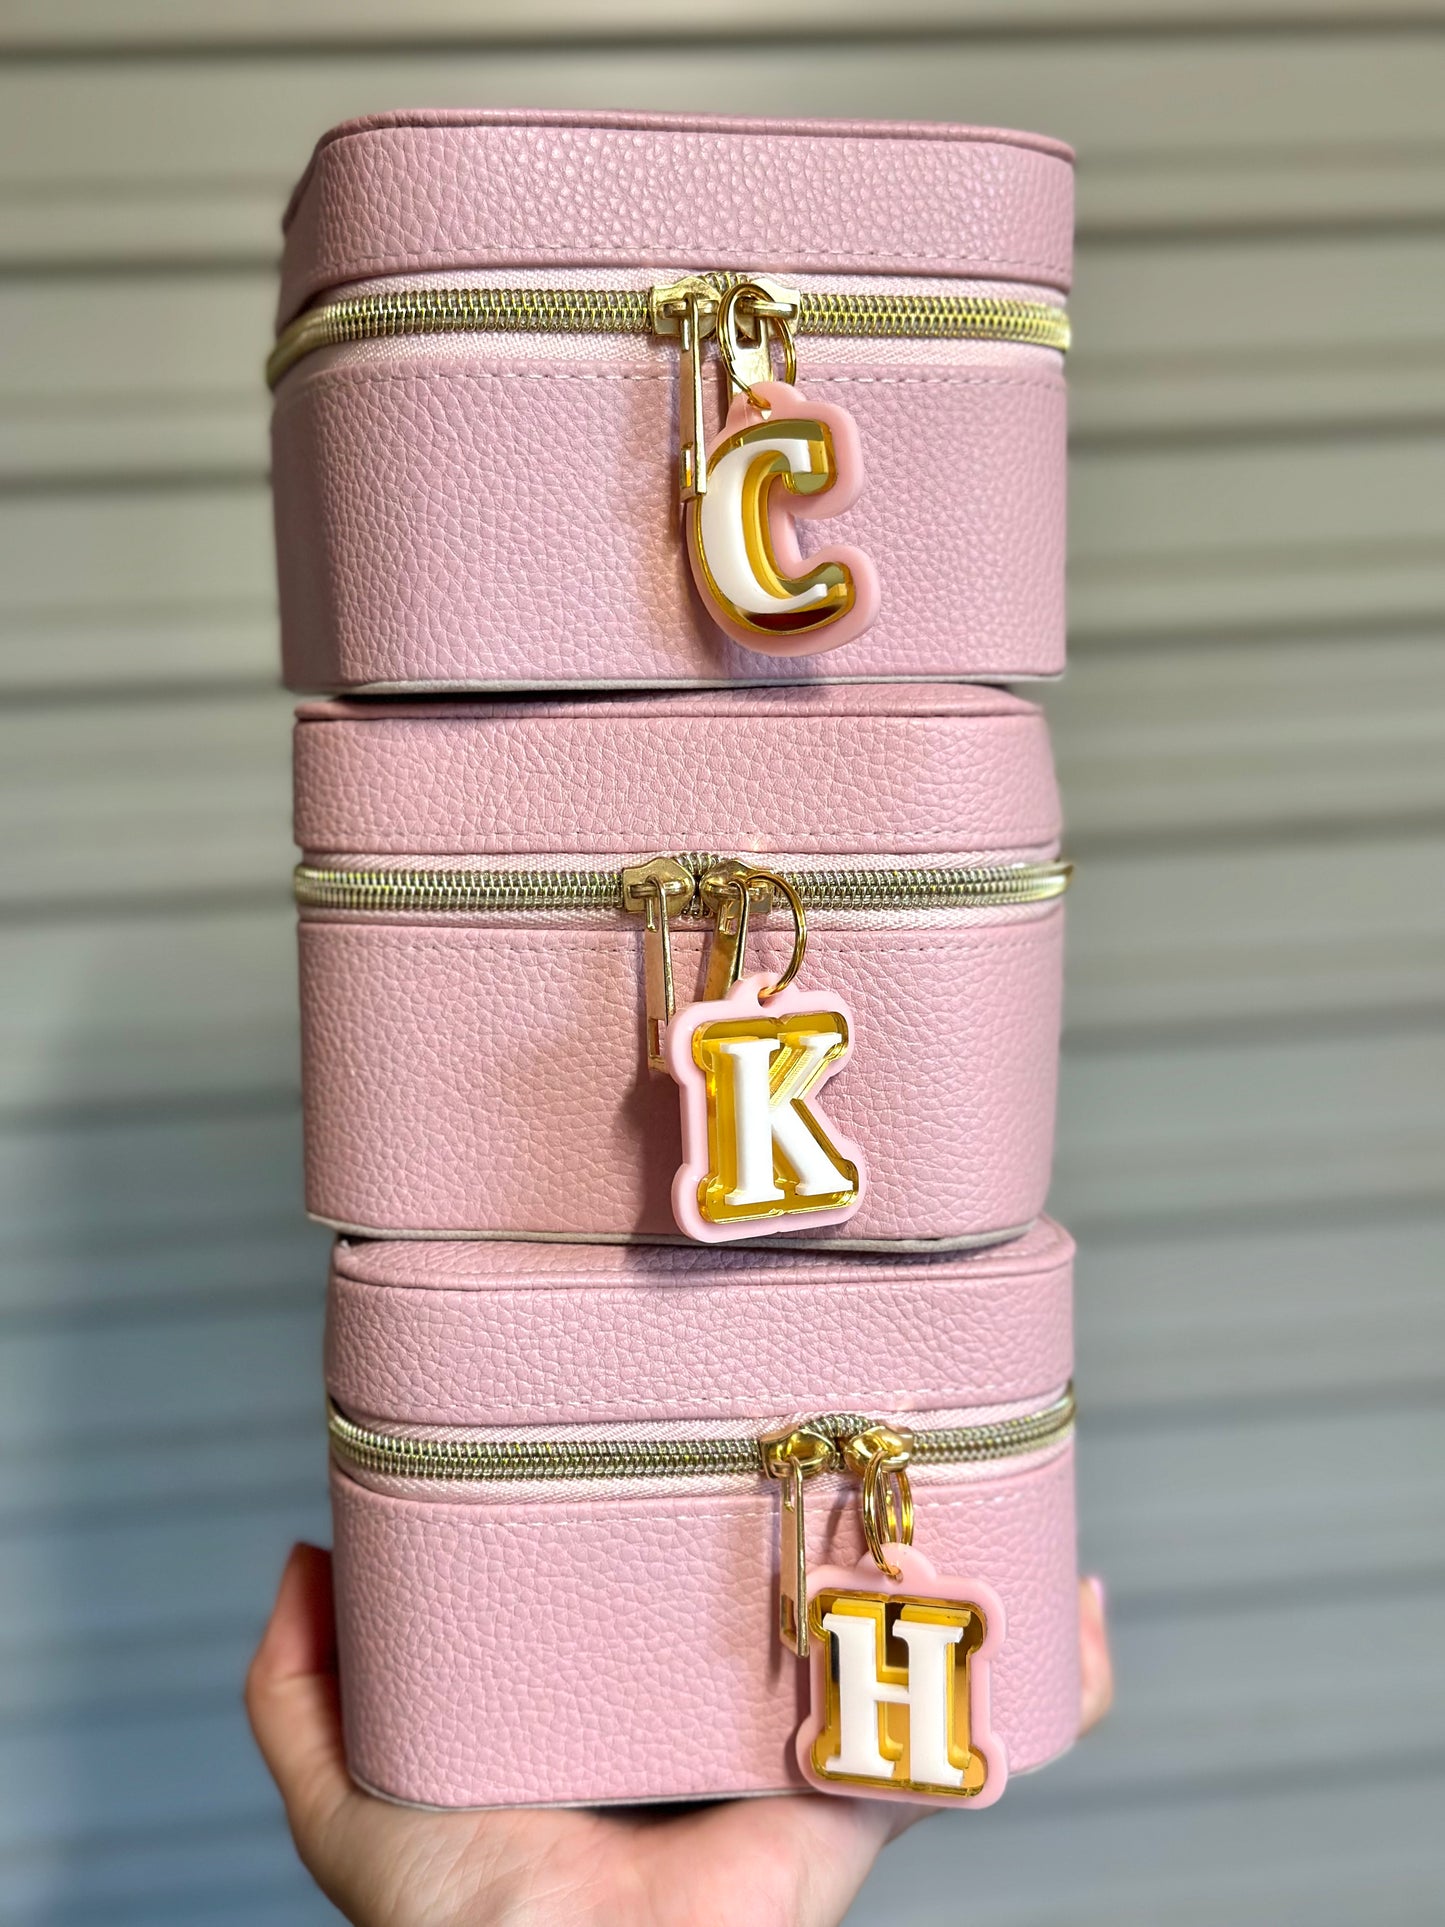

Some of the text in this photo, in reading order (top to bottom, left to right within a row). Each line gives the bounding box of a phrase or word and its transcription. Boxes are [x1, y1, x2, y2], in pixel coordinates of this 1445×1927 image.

[701, 438, 828, 614] C
[719, 1031, 854, 1205] K
[822, 1612, 965, 1786] H
